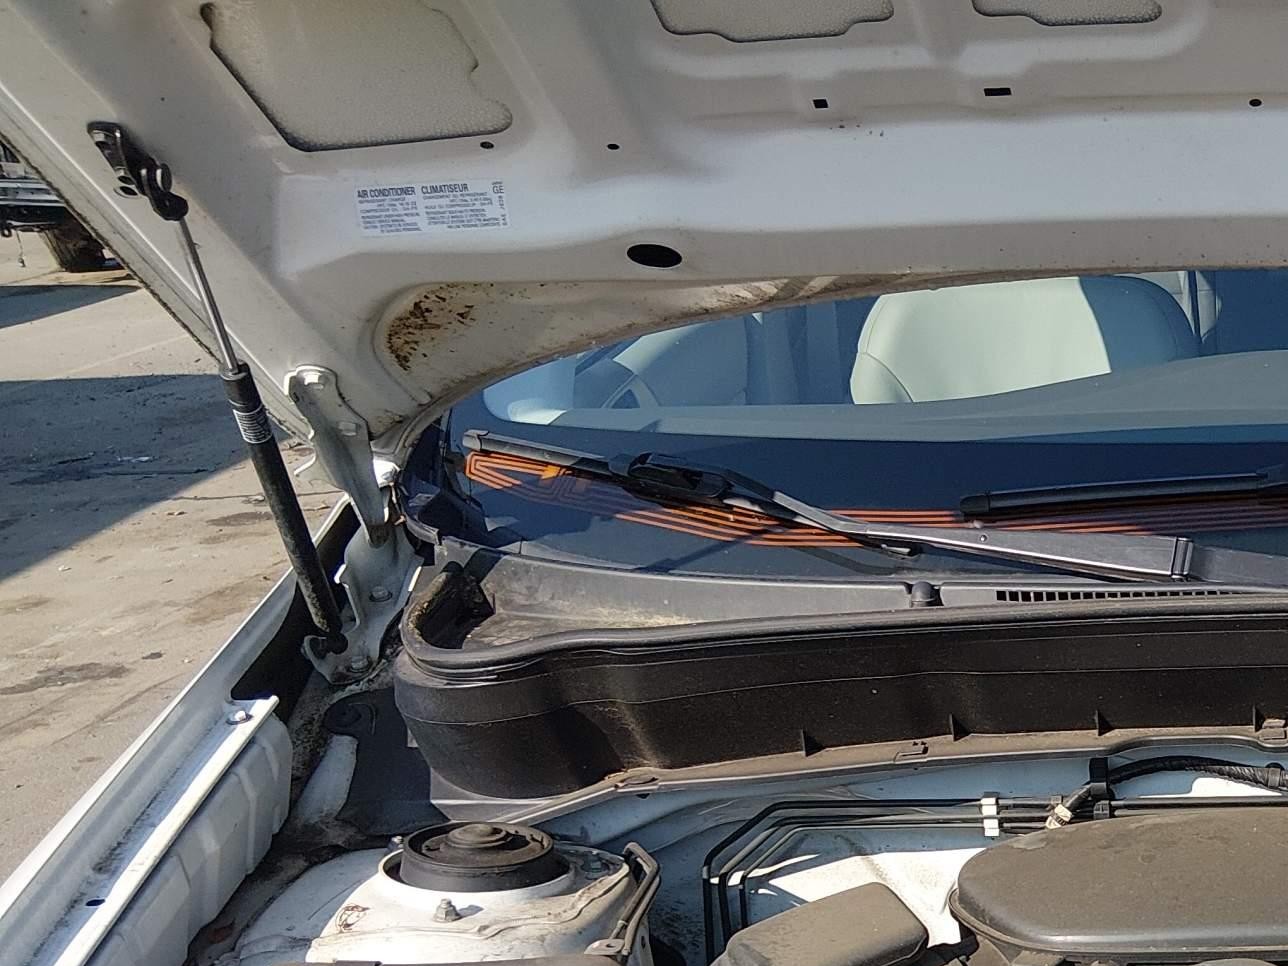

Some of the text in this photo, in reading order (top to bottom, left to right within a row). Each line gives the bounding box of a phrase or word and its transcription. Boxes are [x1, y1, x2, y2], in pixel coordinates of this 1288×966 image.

[357, 186, 416, 199] AIR CONDITIONER
[421, 183, 469, 194] CLIMATISEUR
